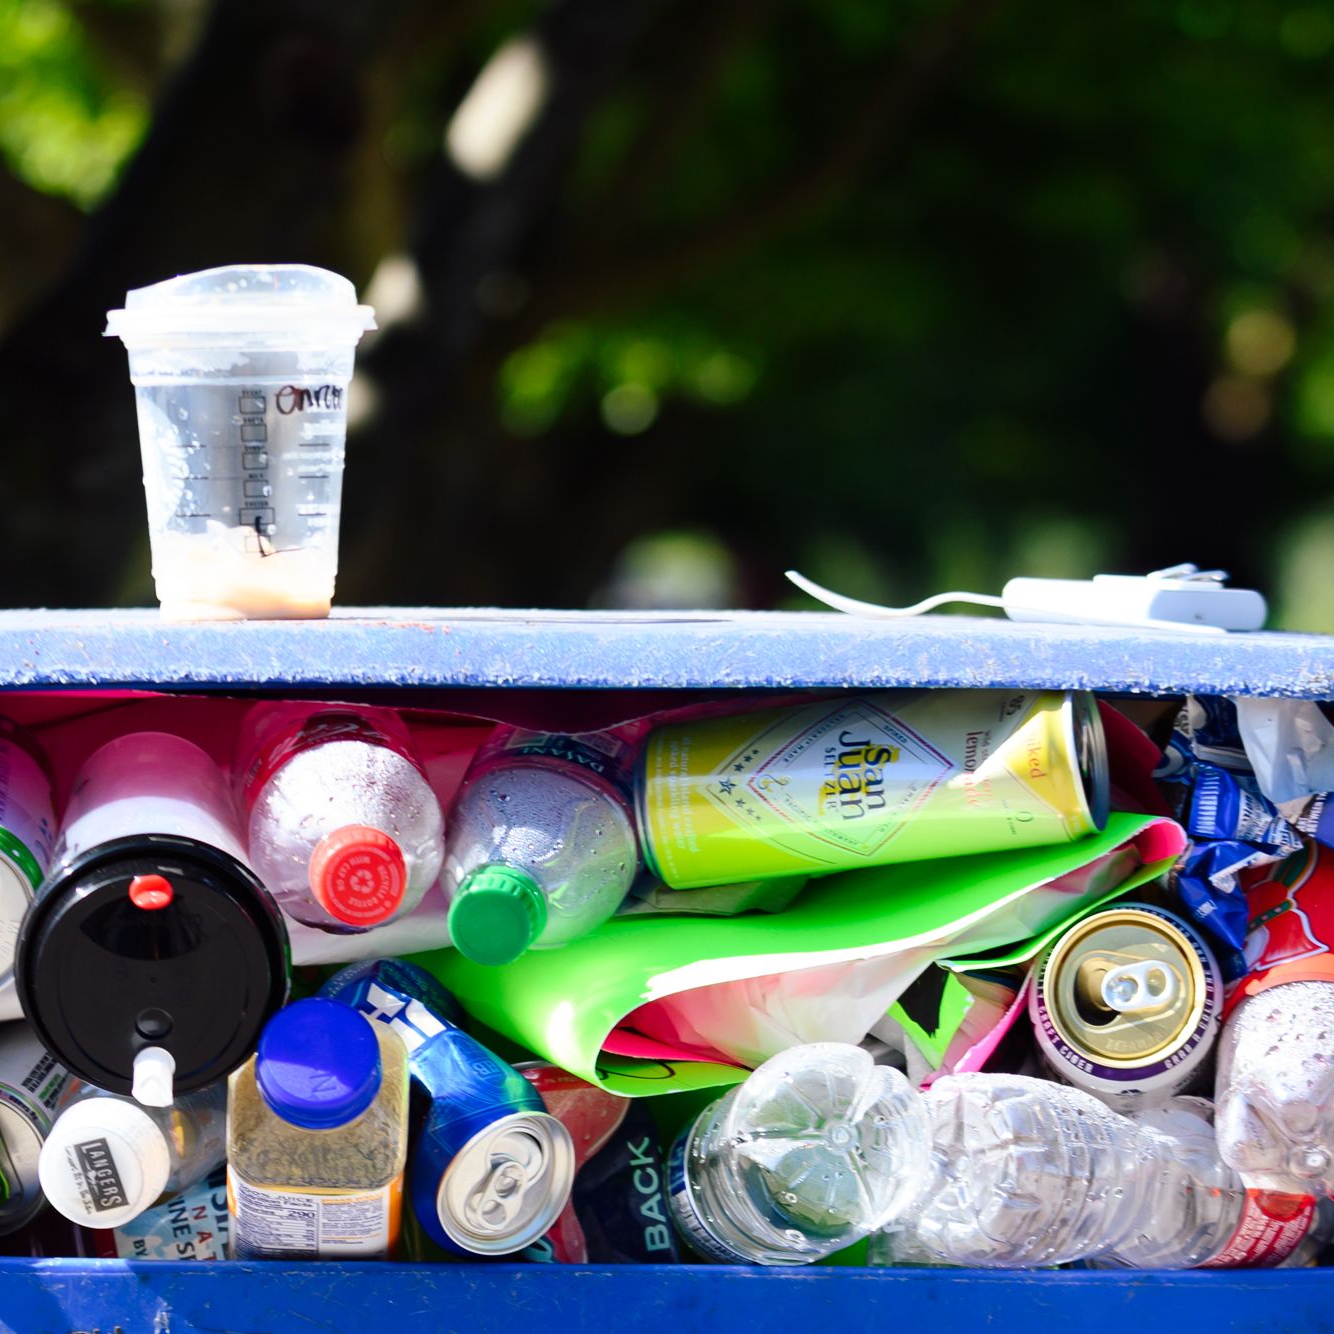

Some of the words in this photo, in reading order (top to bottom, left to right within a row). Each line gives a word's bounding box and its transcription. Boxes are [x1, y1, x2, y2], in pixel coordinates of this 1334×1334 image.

[521, 746, 604, 774] DASANI
[837, 730, 871, 820] Juan
[864, 747, 893, 810] San
[1037, 1004, 1061, 1045] CRAFT
[1057, 1043, 1094, 1074] CIDER
[80, 1141, 123, 1208] LANGERS
[627, 1136, 671, 1252] BACK
[168, 1195, 192, 1238] INE
[288, 1210, 316, 1219] 290
[133, 1239, 149, 1257] BY
